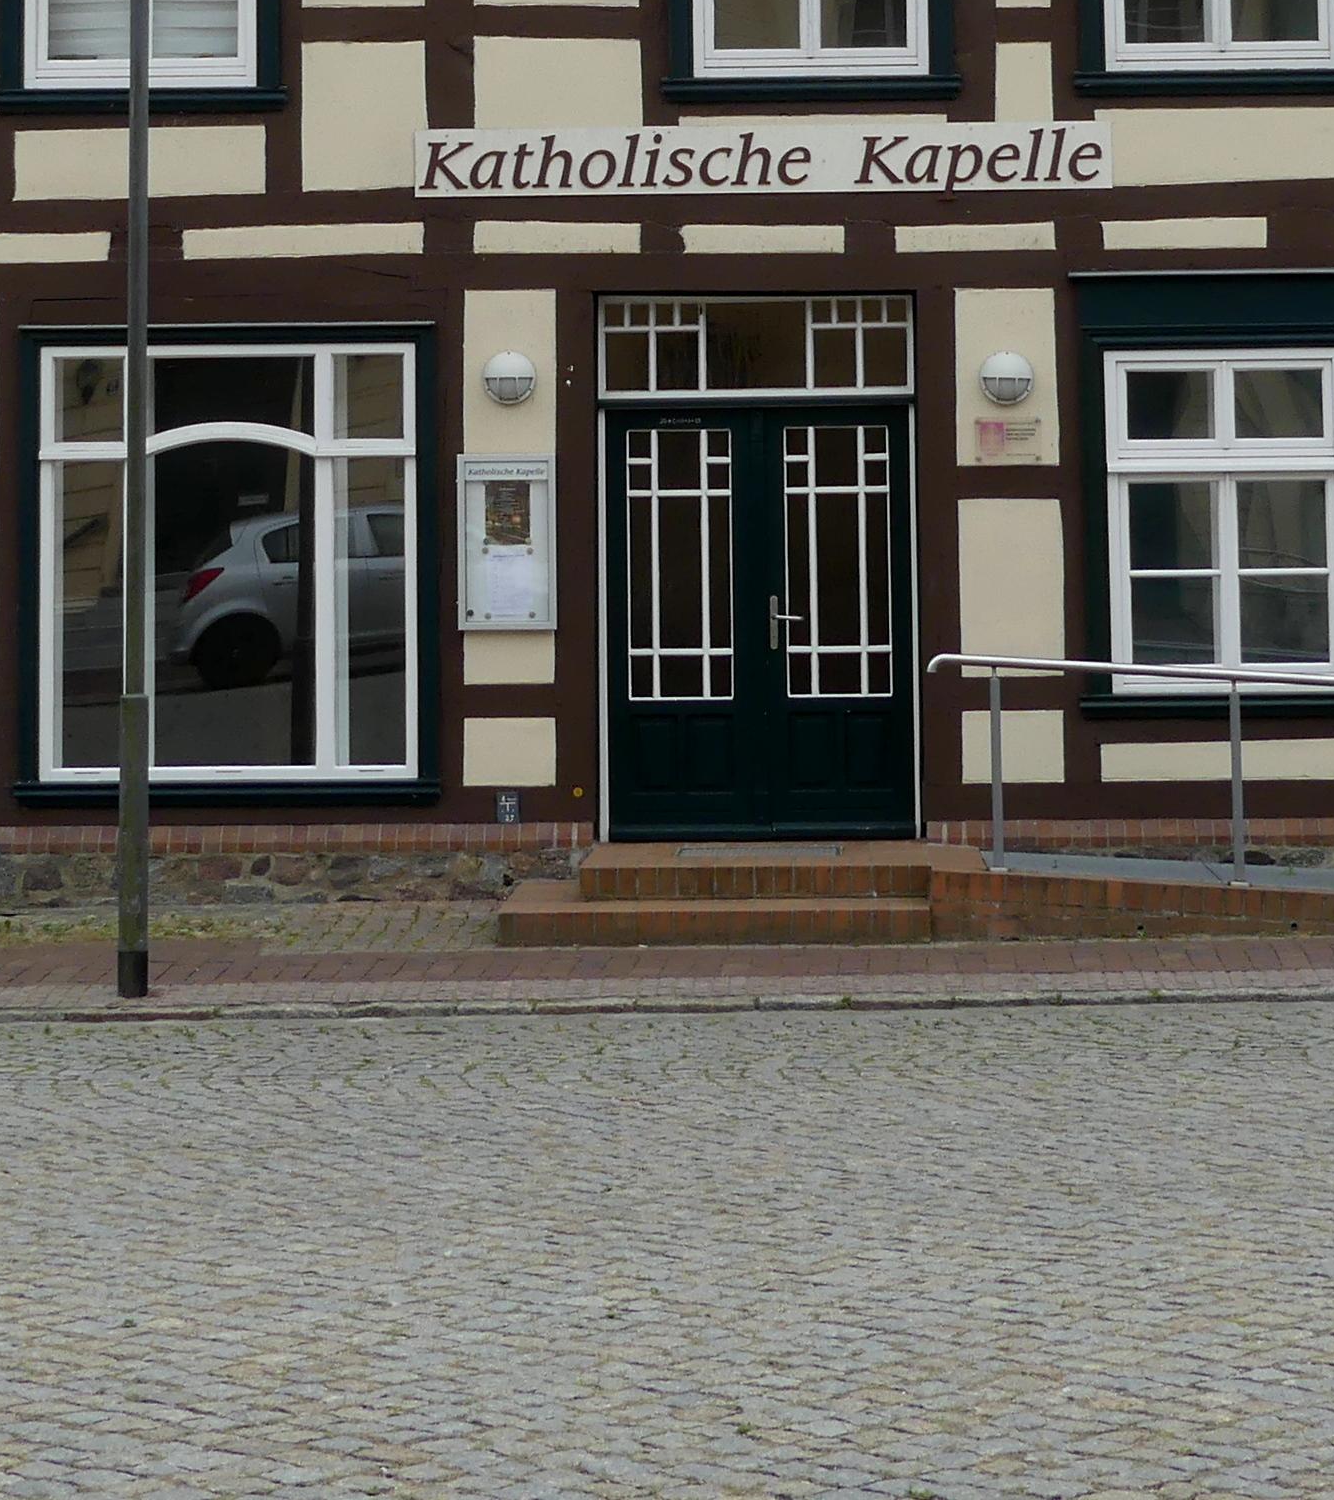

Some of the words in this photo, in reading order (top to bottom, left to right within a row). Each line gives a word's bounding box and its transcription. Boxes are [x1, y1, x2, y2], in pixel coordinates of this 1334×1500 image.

[419, 132, 810, 190] Katholische
[854, 127, 1102, 200] Kapelle
[468, 467, 514, 476] Katholische
[516, 467, 545, 477] Kapelle
